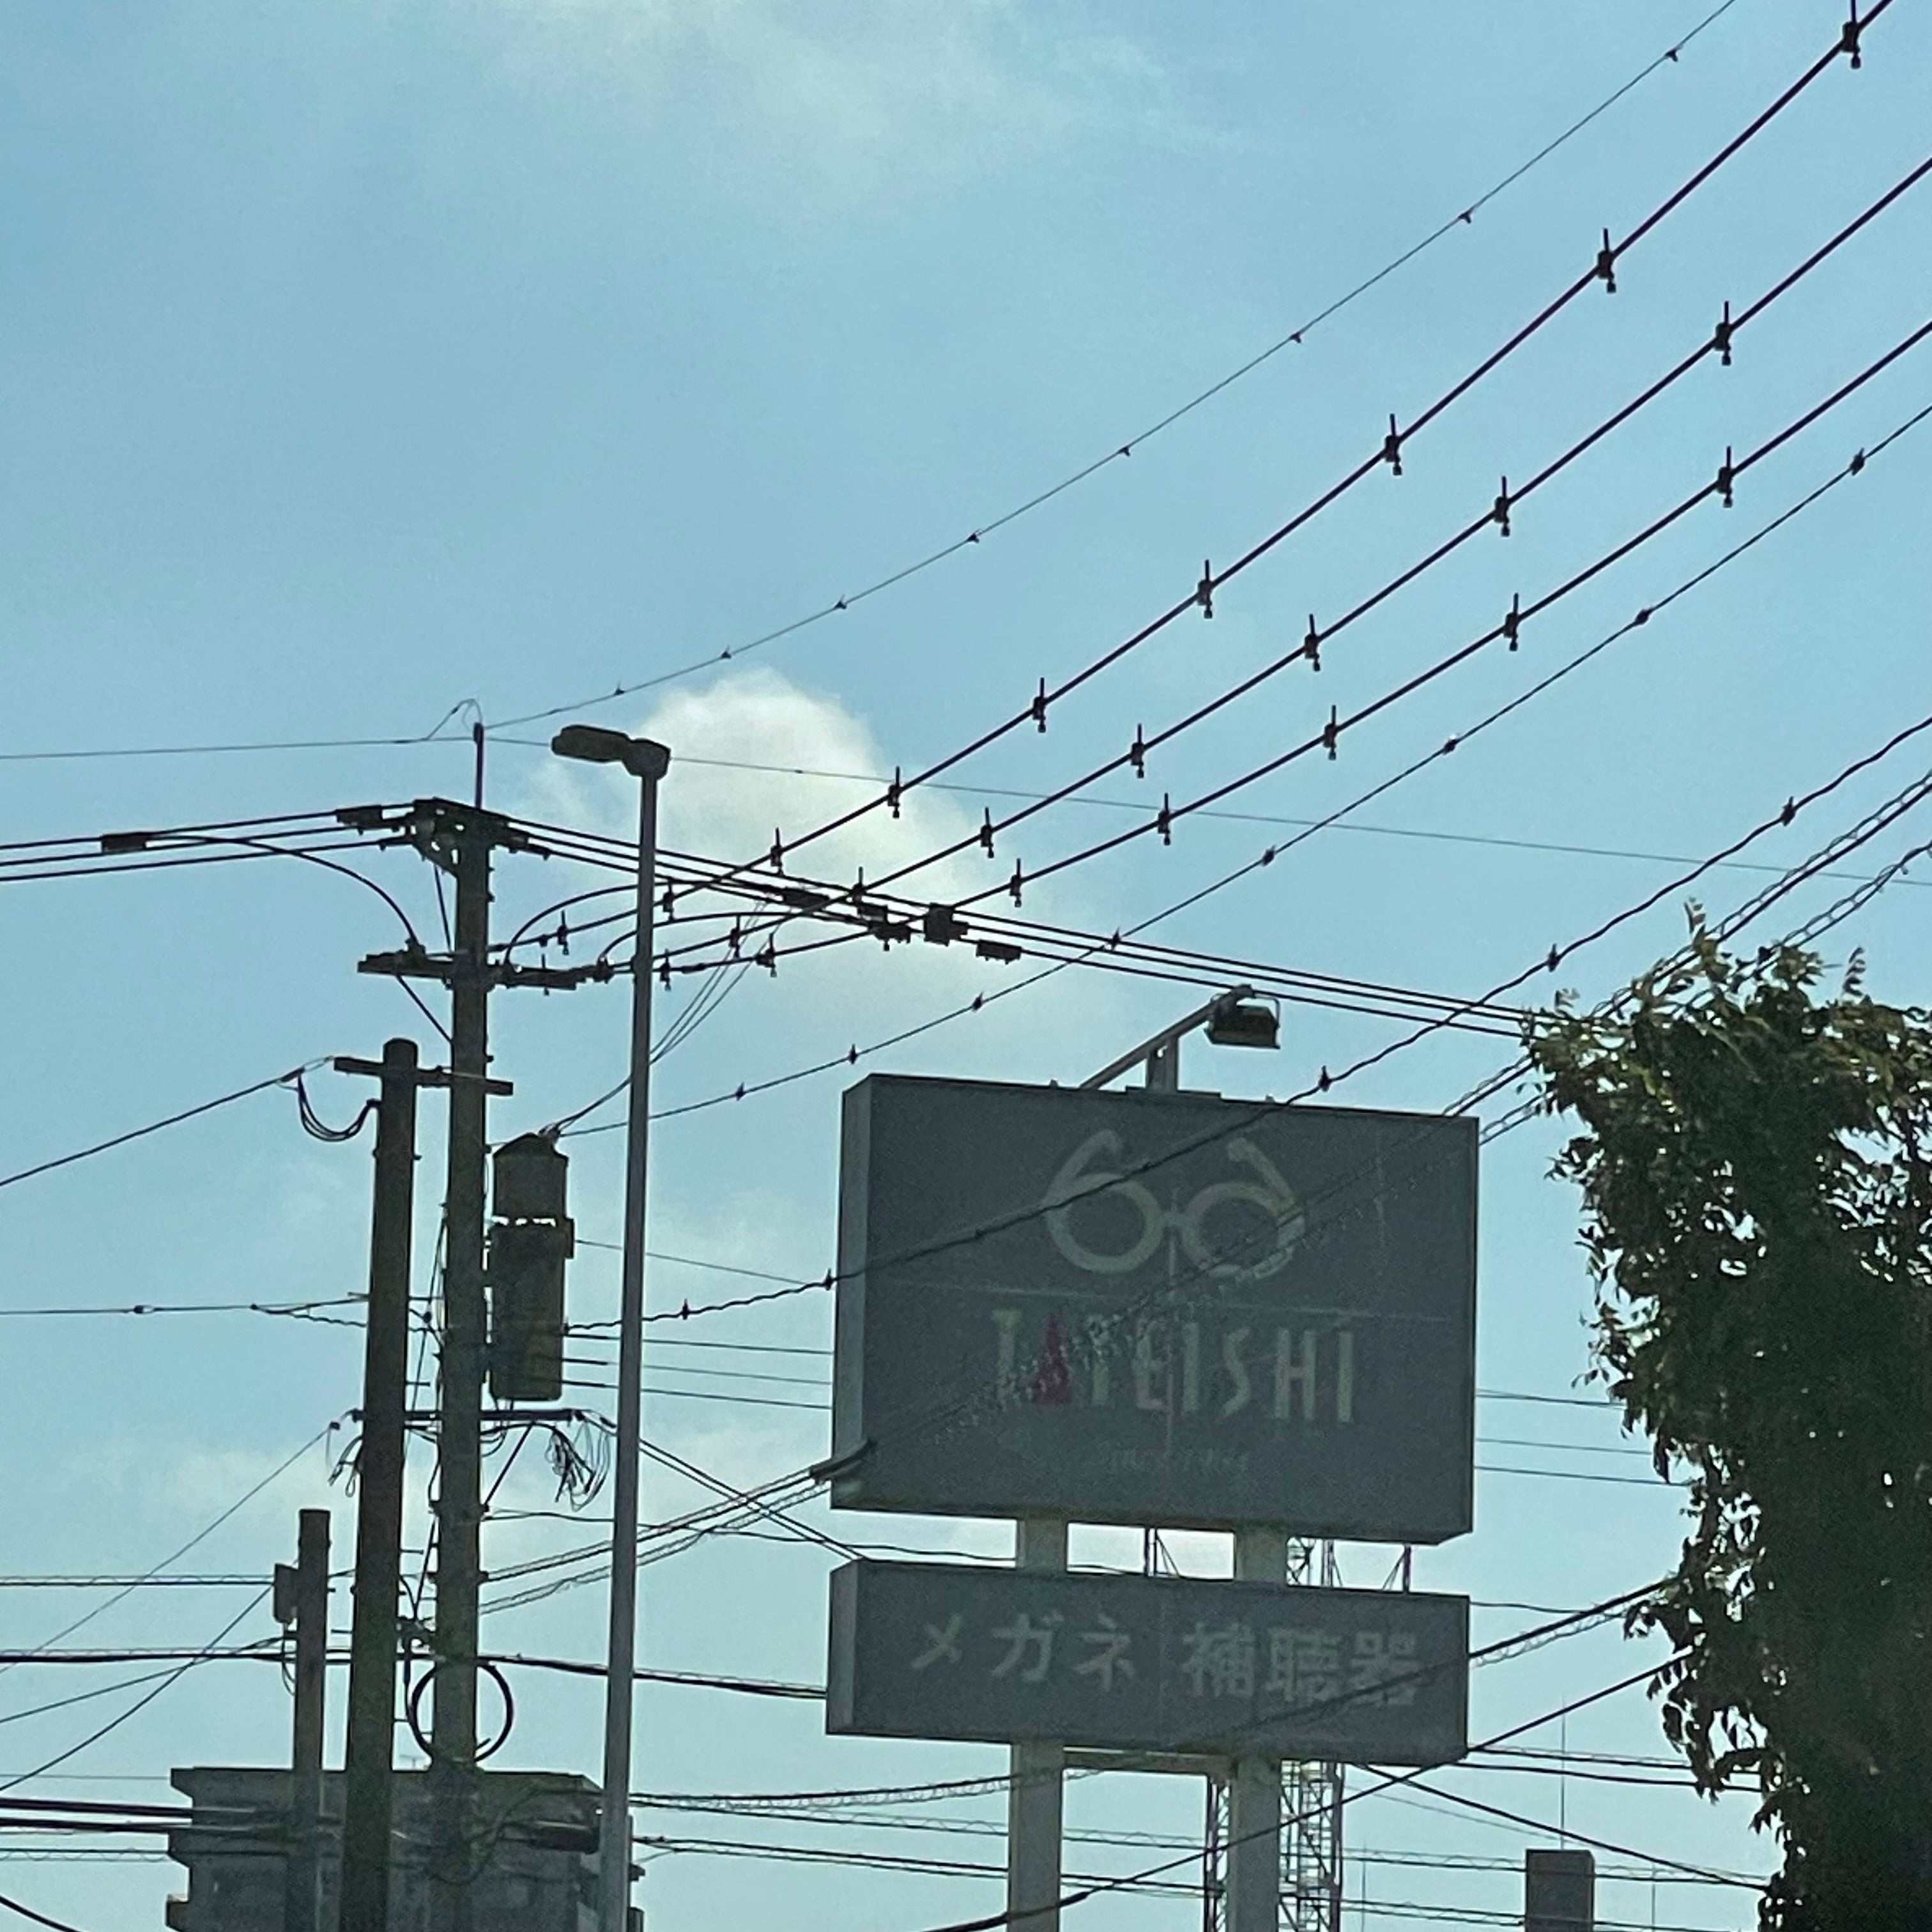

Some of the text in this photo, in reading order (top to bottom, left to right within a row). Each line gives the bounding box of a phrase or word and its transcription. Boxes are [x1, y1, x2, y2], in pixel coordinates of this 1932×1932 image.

[910, 1609, 1421, 1708] メガネ 補聴器
